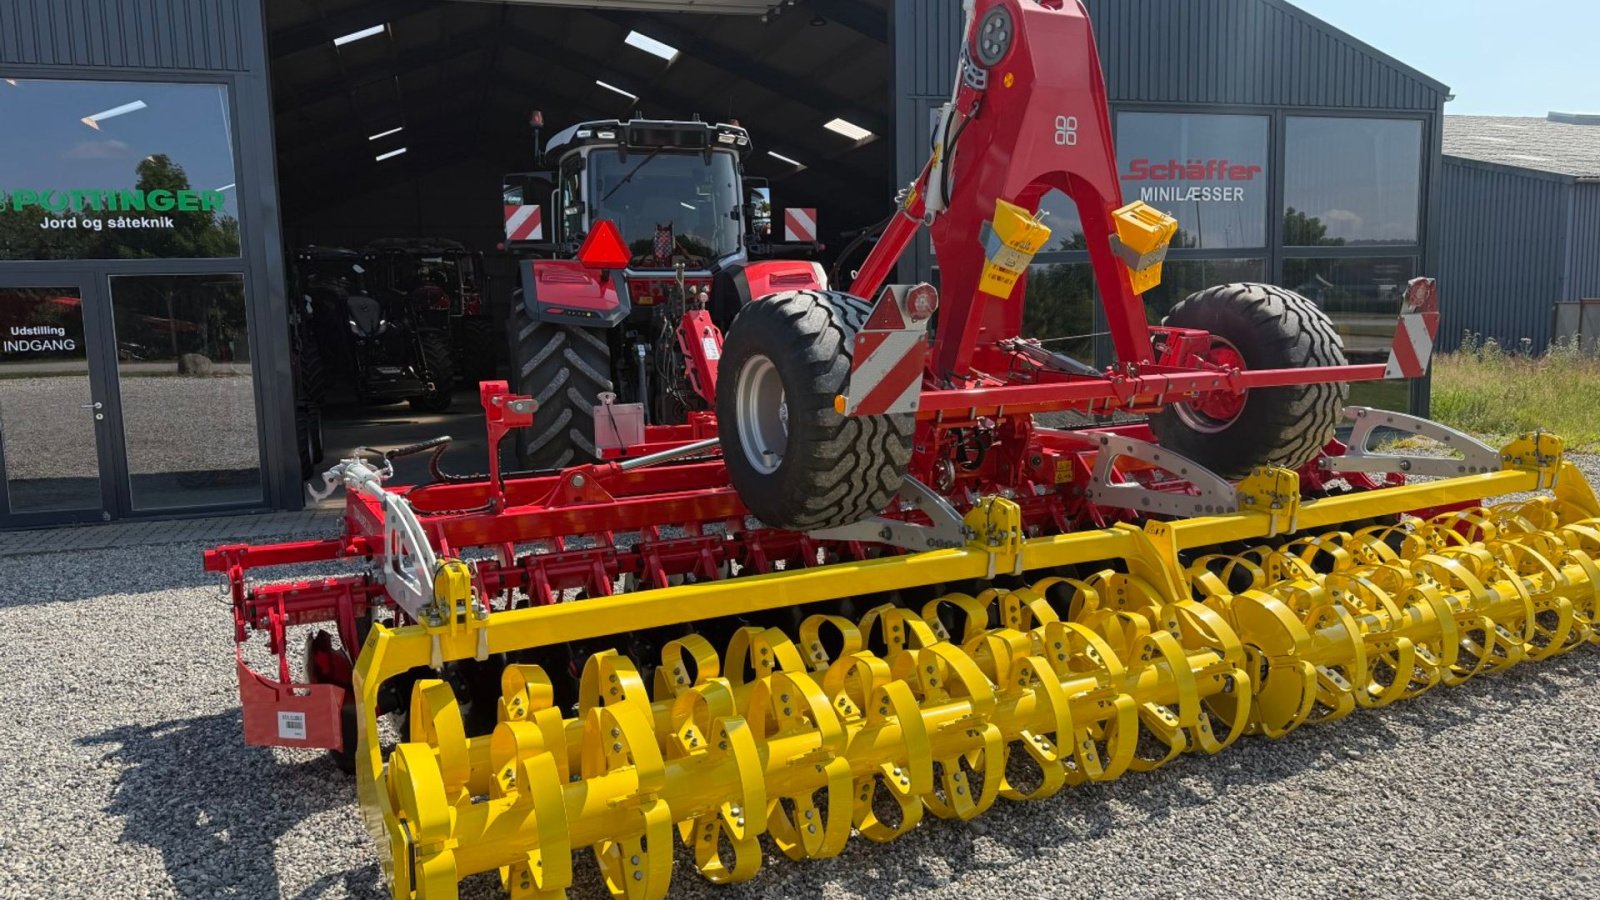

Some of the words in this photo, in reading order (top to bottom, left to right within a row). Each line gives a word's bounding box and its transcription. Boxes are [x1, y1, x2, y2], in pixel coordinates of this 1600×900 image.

[1120, 158, 1262, 181] Schäffer
[1140, 186, 1244, 201] MINILÆSSER
[40, 216, 77, 229] Jord
[82, 219, 103, 231] og
[107, 215, 174, 228] såteknik
[10, 325, 66, 337] Udstilling
[3, 338, 76, 353] INDGANG
